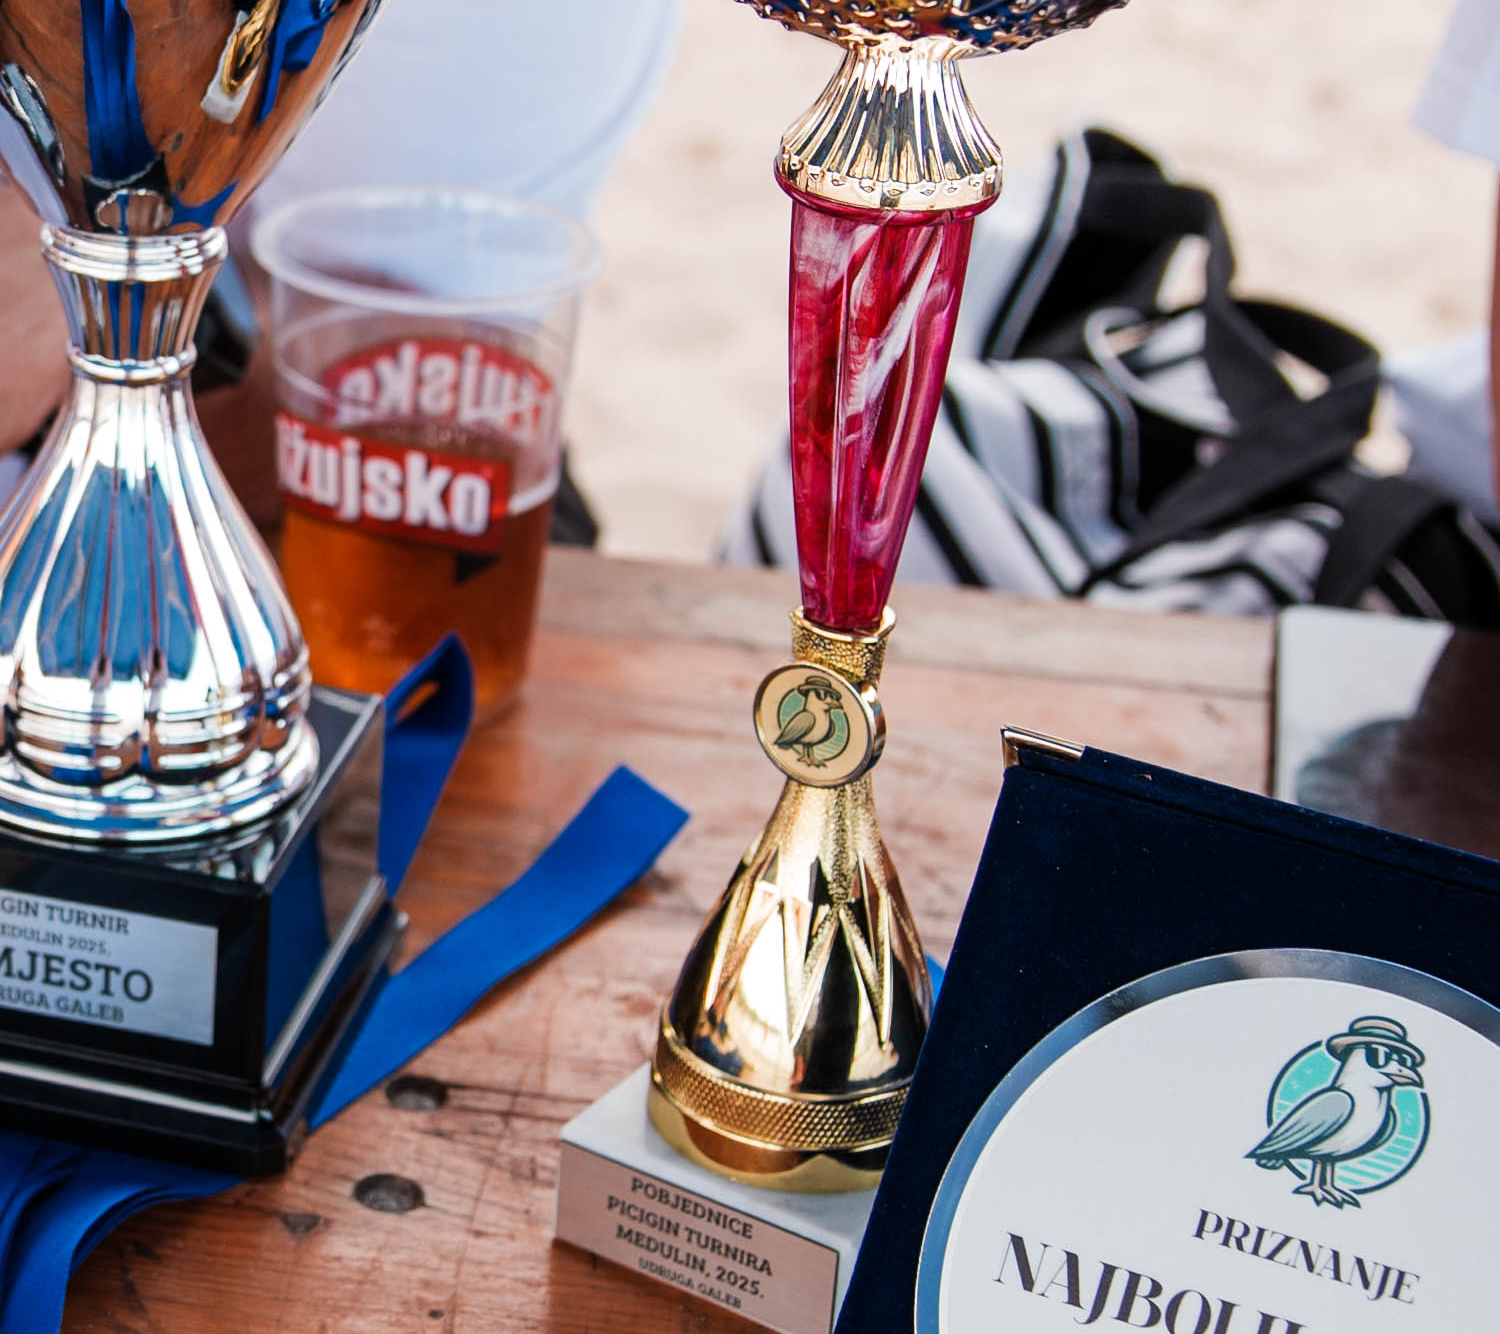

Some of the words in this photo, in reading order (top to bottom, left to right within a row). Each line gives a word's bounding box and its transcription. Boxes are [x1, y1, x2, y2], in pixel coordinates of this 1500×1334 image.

[45, 904, 129, 934] TURNIR
[68, 935, 111, 956] 2025.
[55, 995, 125, 1024] GALEB
[607, 1195, 680, 1238] PICIGIN
[685, 1227, 773, 1277] TURNIRA
[630, 1176, 754, 1239] POBJEDNICE
[615, 1224, 711, 1278] MEDULIN,
[716, 1266, 764, 1299] 2025.
[638, 1257, 694, 1289] UDRUGA
[697, 1280, 741, 1309] GALEB
[1193, 1207, 1421, 1307] PRIZNANJE
